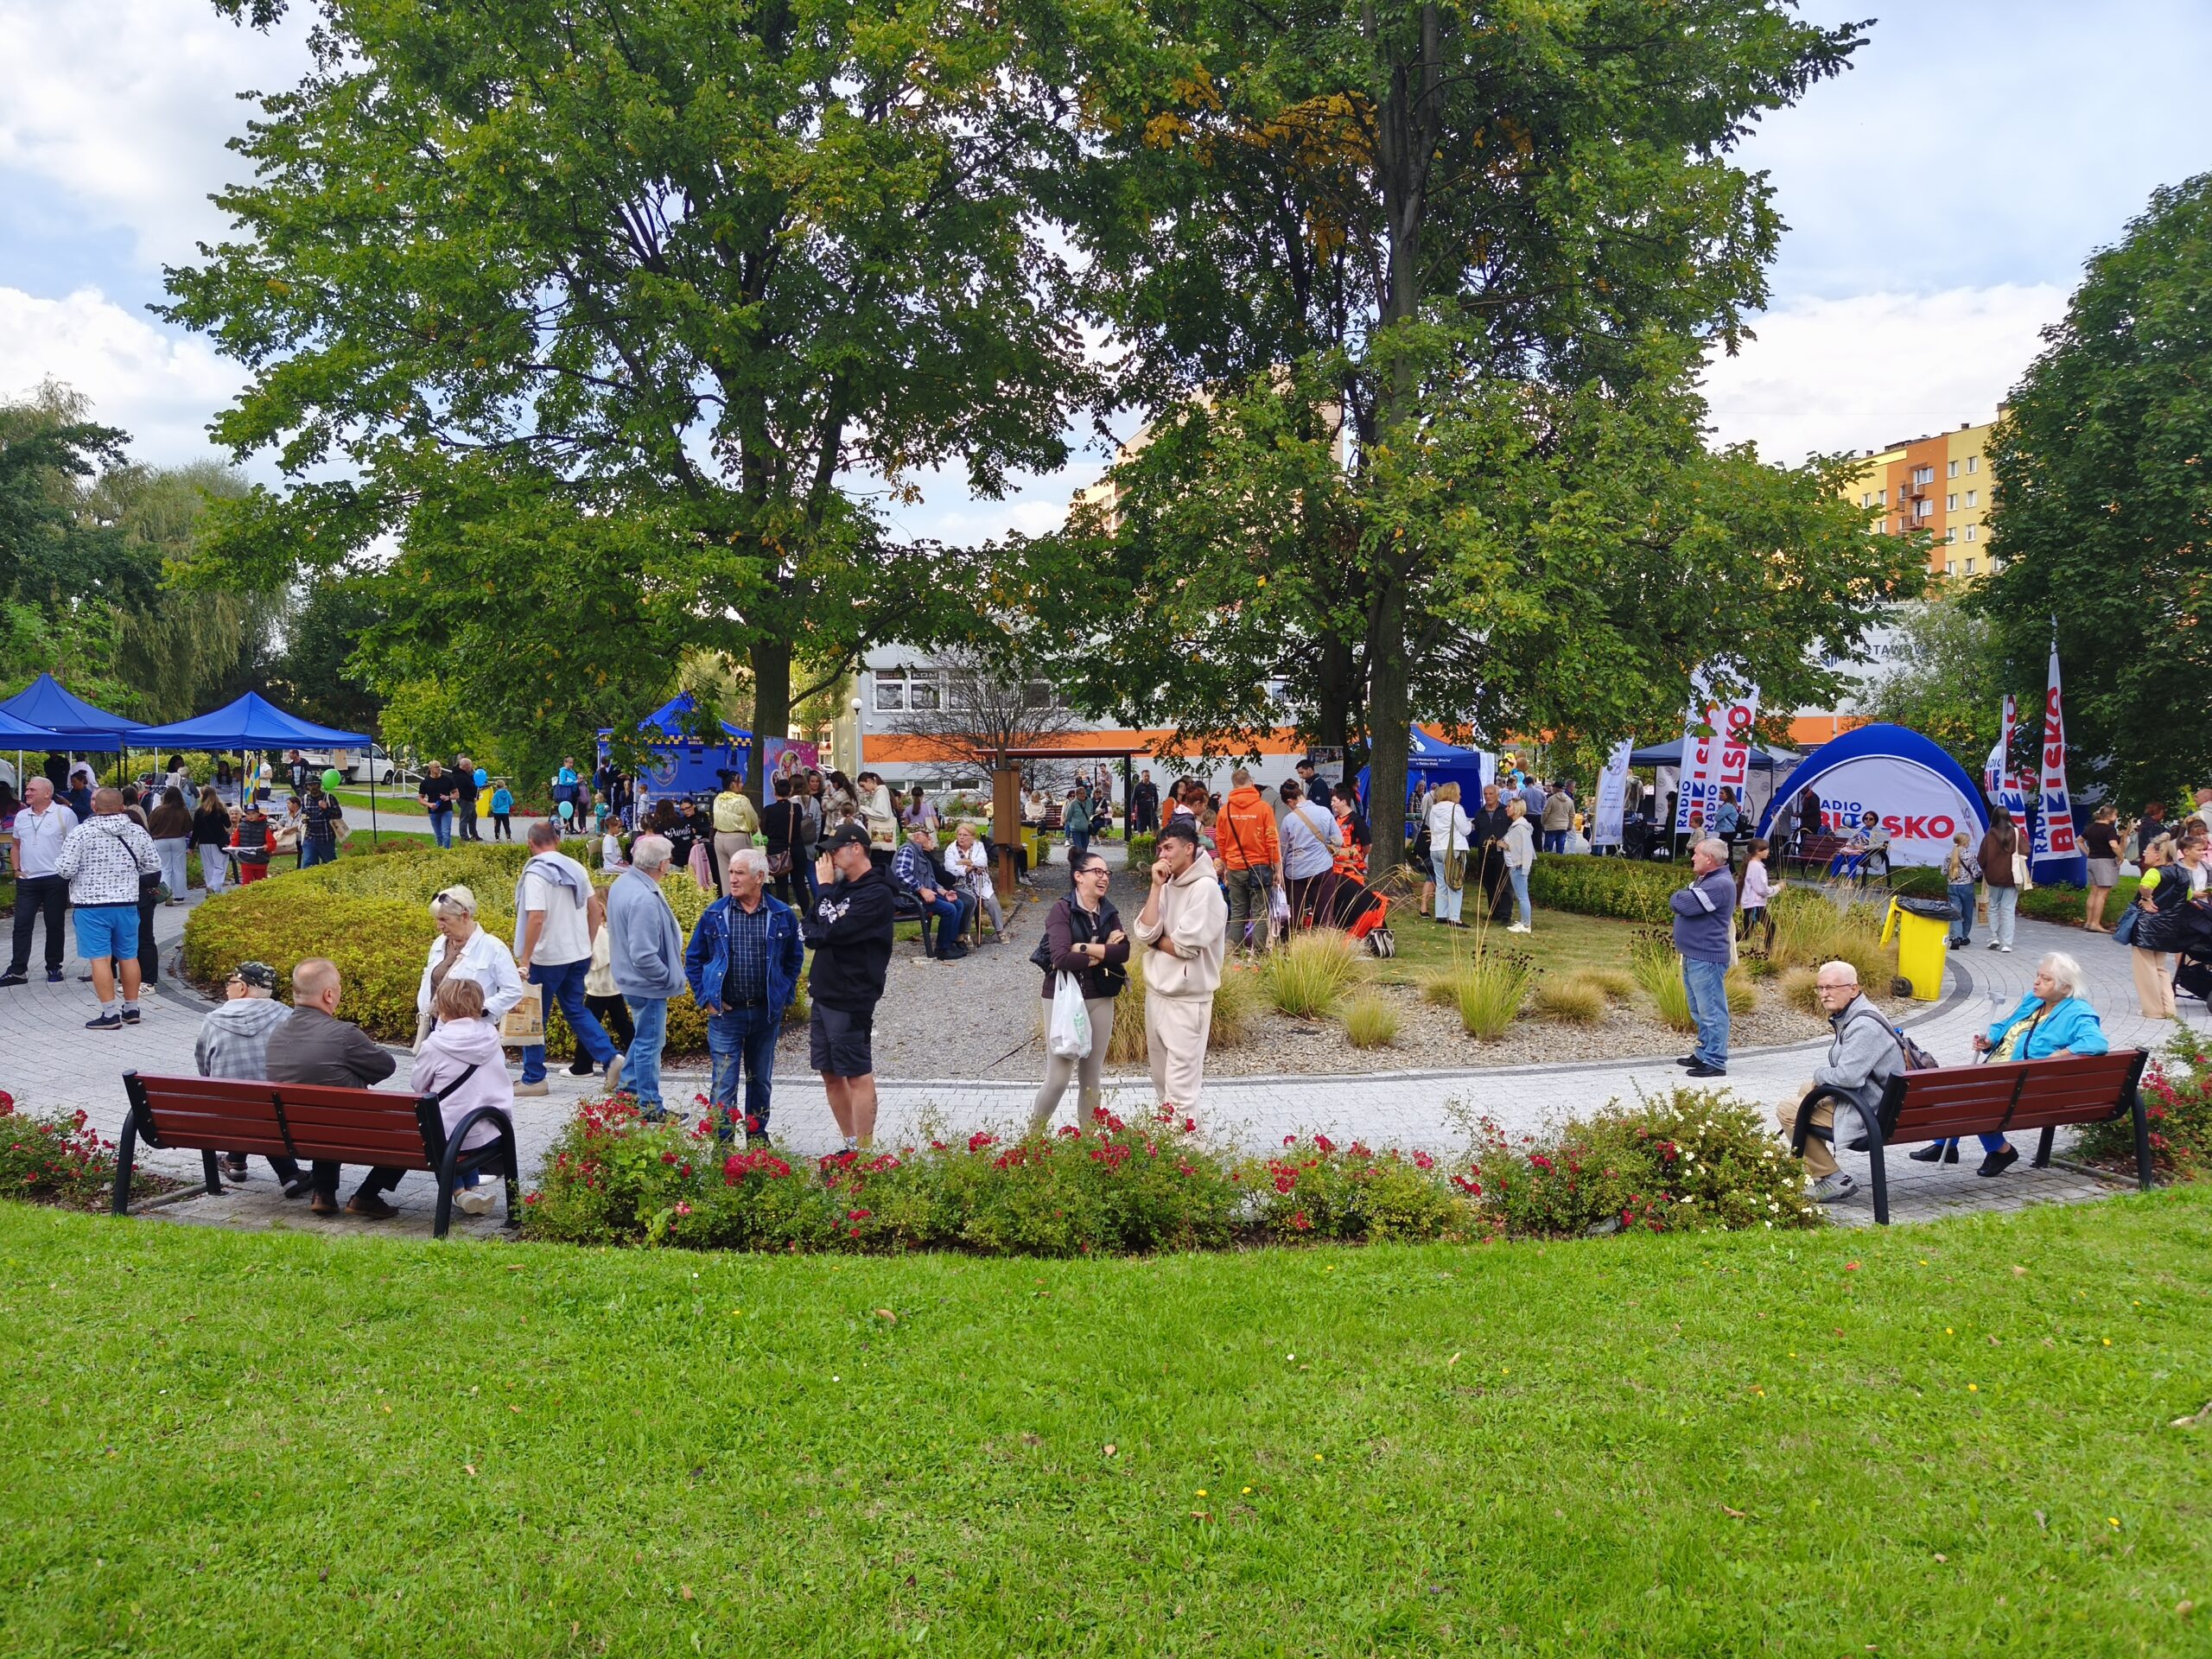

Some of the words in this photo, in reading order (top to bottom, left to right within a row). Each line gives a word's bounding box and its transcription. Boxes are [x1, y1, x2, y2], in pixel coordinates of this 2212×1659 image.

[1676, 781, 1691, 828] RADIO
[1705, 785, 1718, 832] RADIO
[1821, 799, 1862, 811] ADIO
